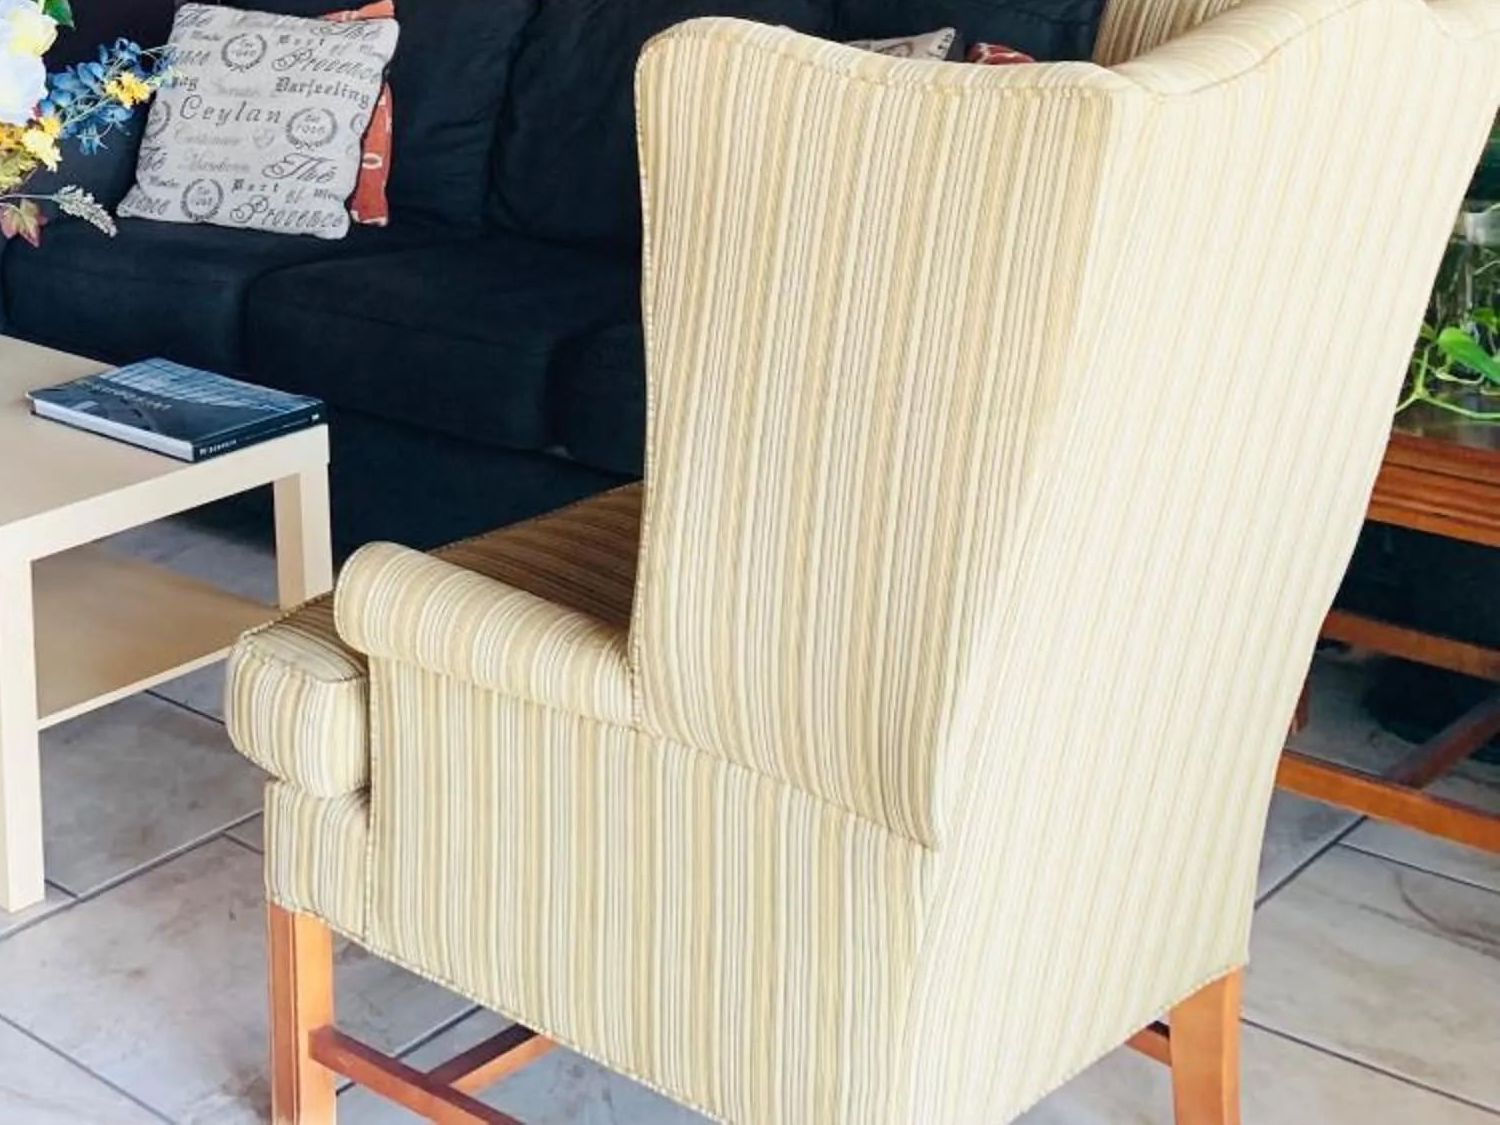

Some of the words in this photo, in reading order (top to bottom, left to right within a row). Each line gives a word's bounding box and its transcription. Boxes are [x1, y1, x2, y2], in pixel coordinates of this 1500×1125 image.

[275, 76, 370, 109] Darjeeling
[179, 94, 282, 126] Ceylan
[230, 194, 345, 228] Provence
